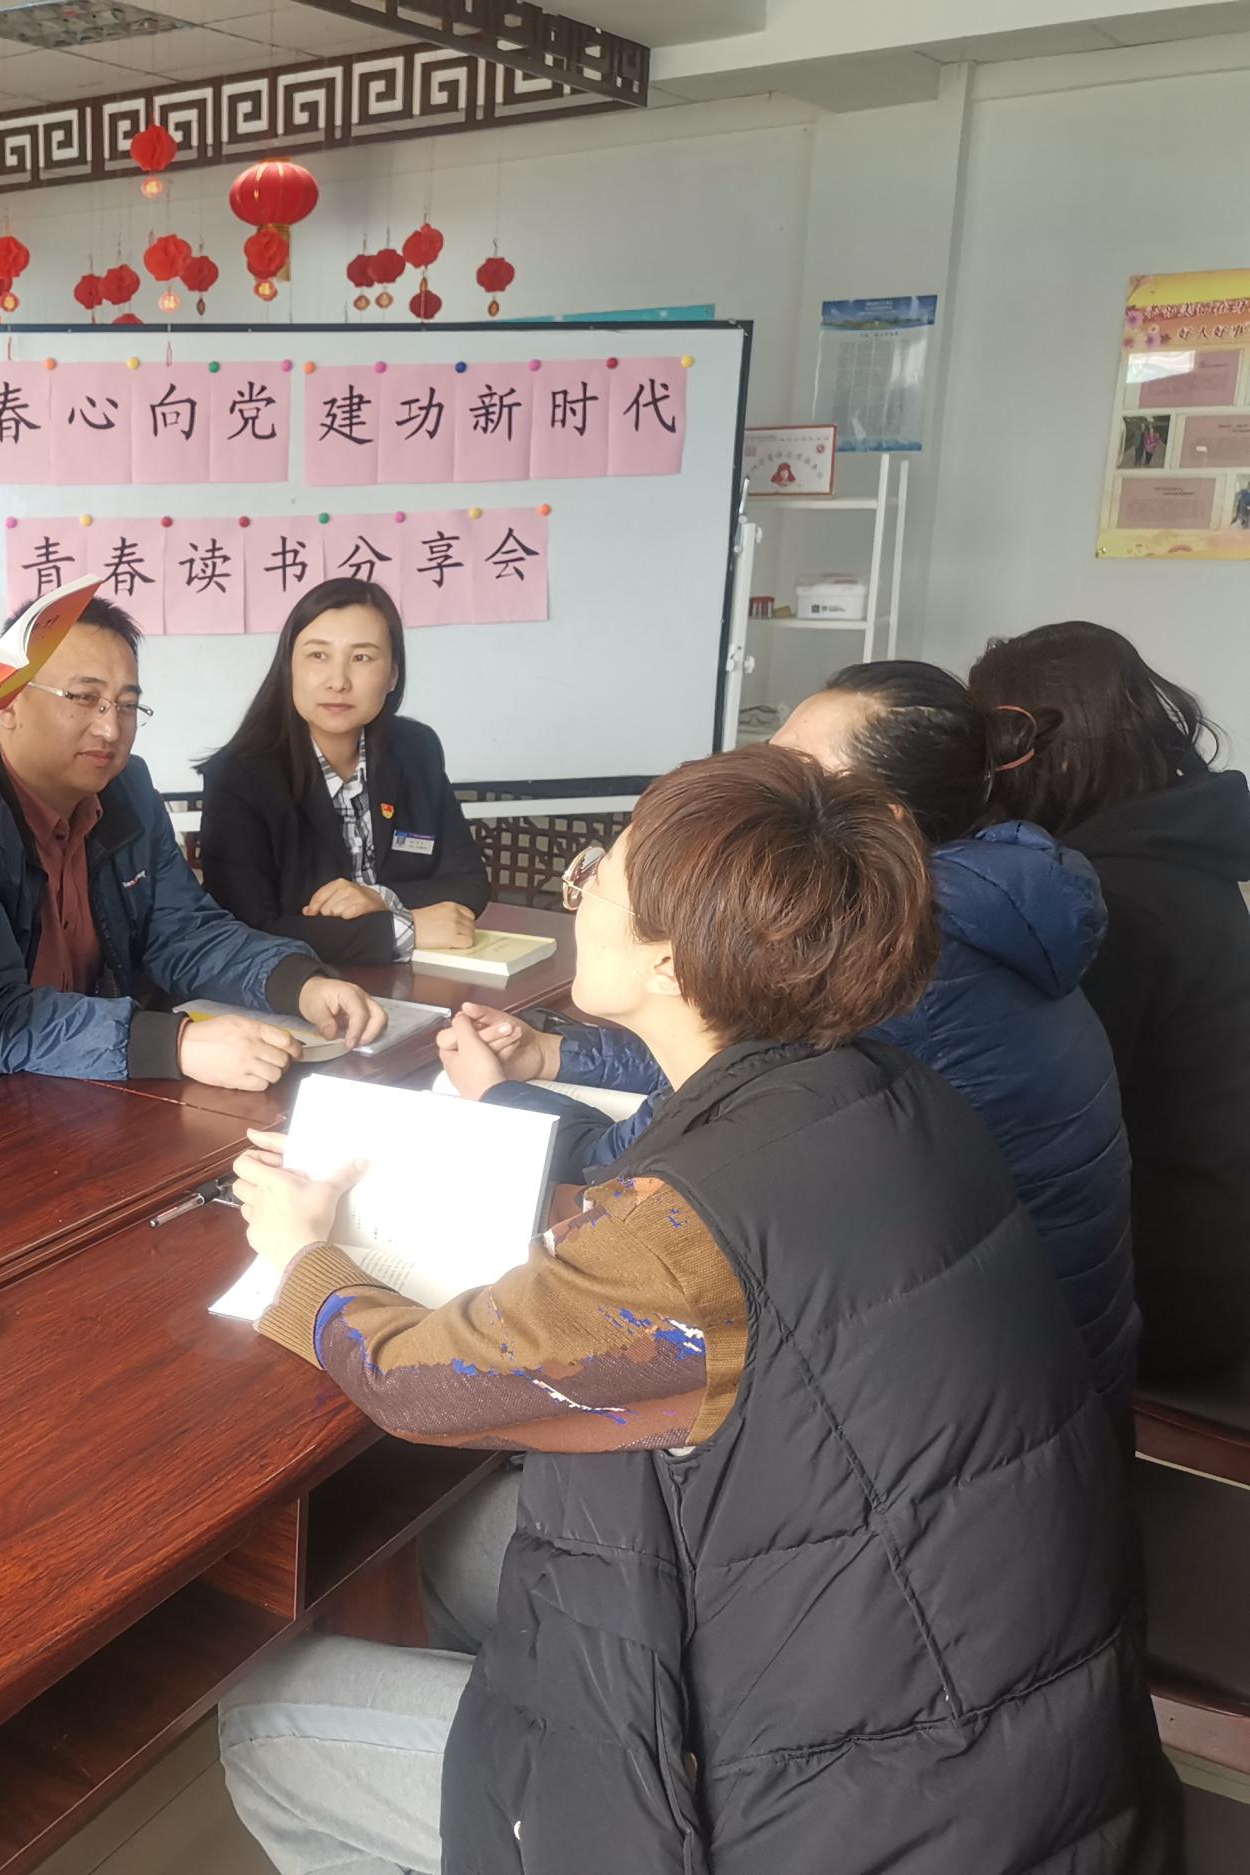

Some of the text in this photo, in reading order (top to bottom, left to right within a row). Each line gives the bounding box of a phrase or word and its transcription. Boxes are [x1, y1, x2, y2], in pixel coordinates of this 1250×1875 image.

[318, 378, 677, 445] 建功新时代
[21, 527, 541, 597] 青春读书分享会
